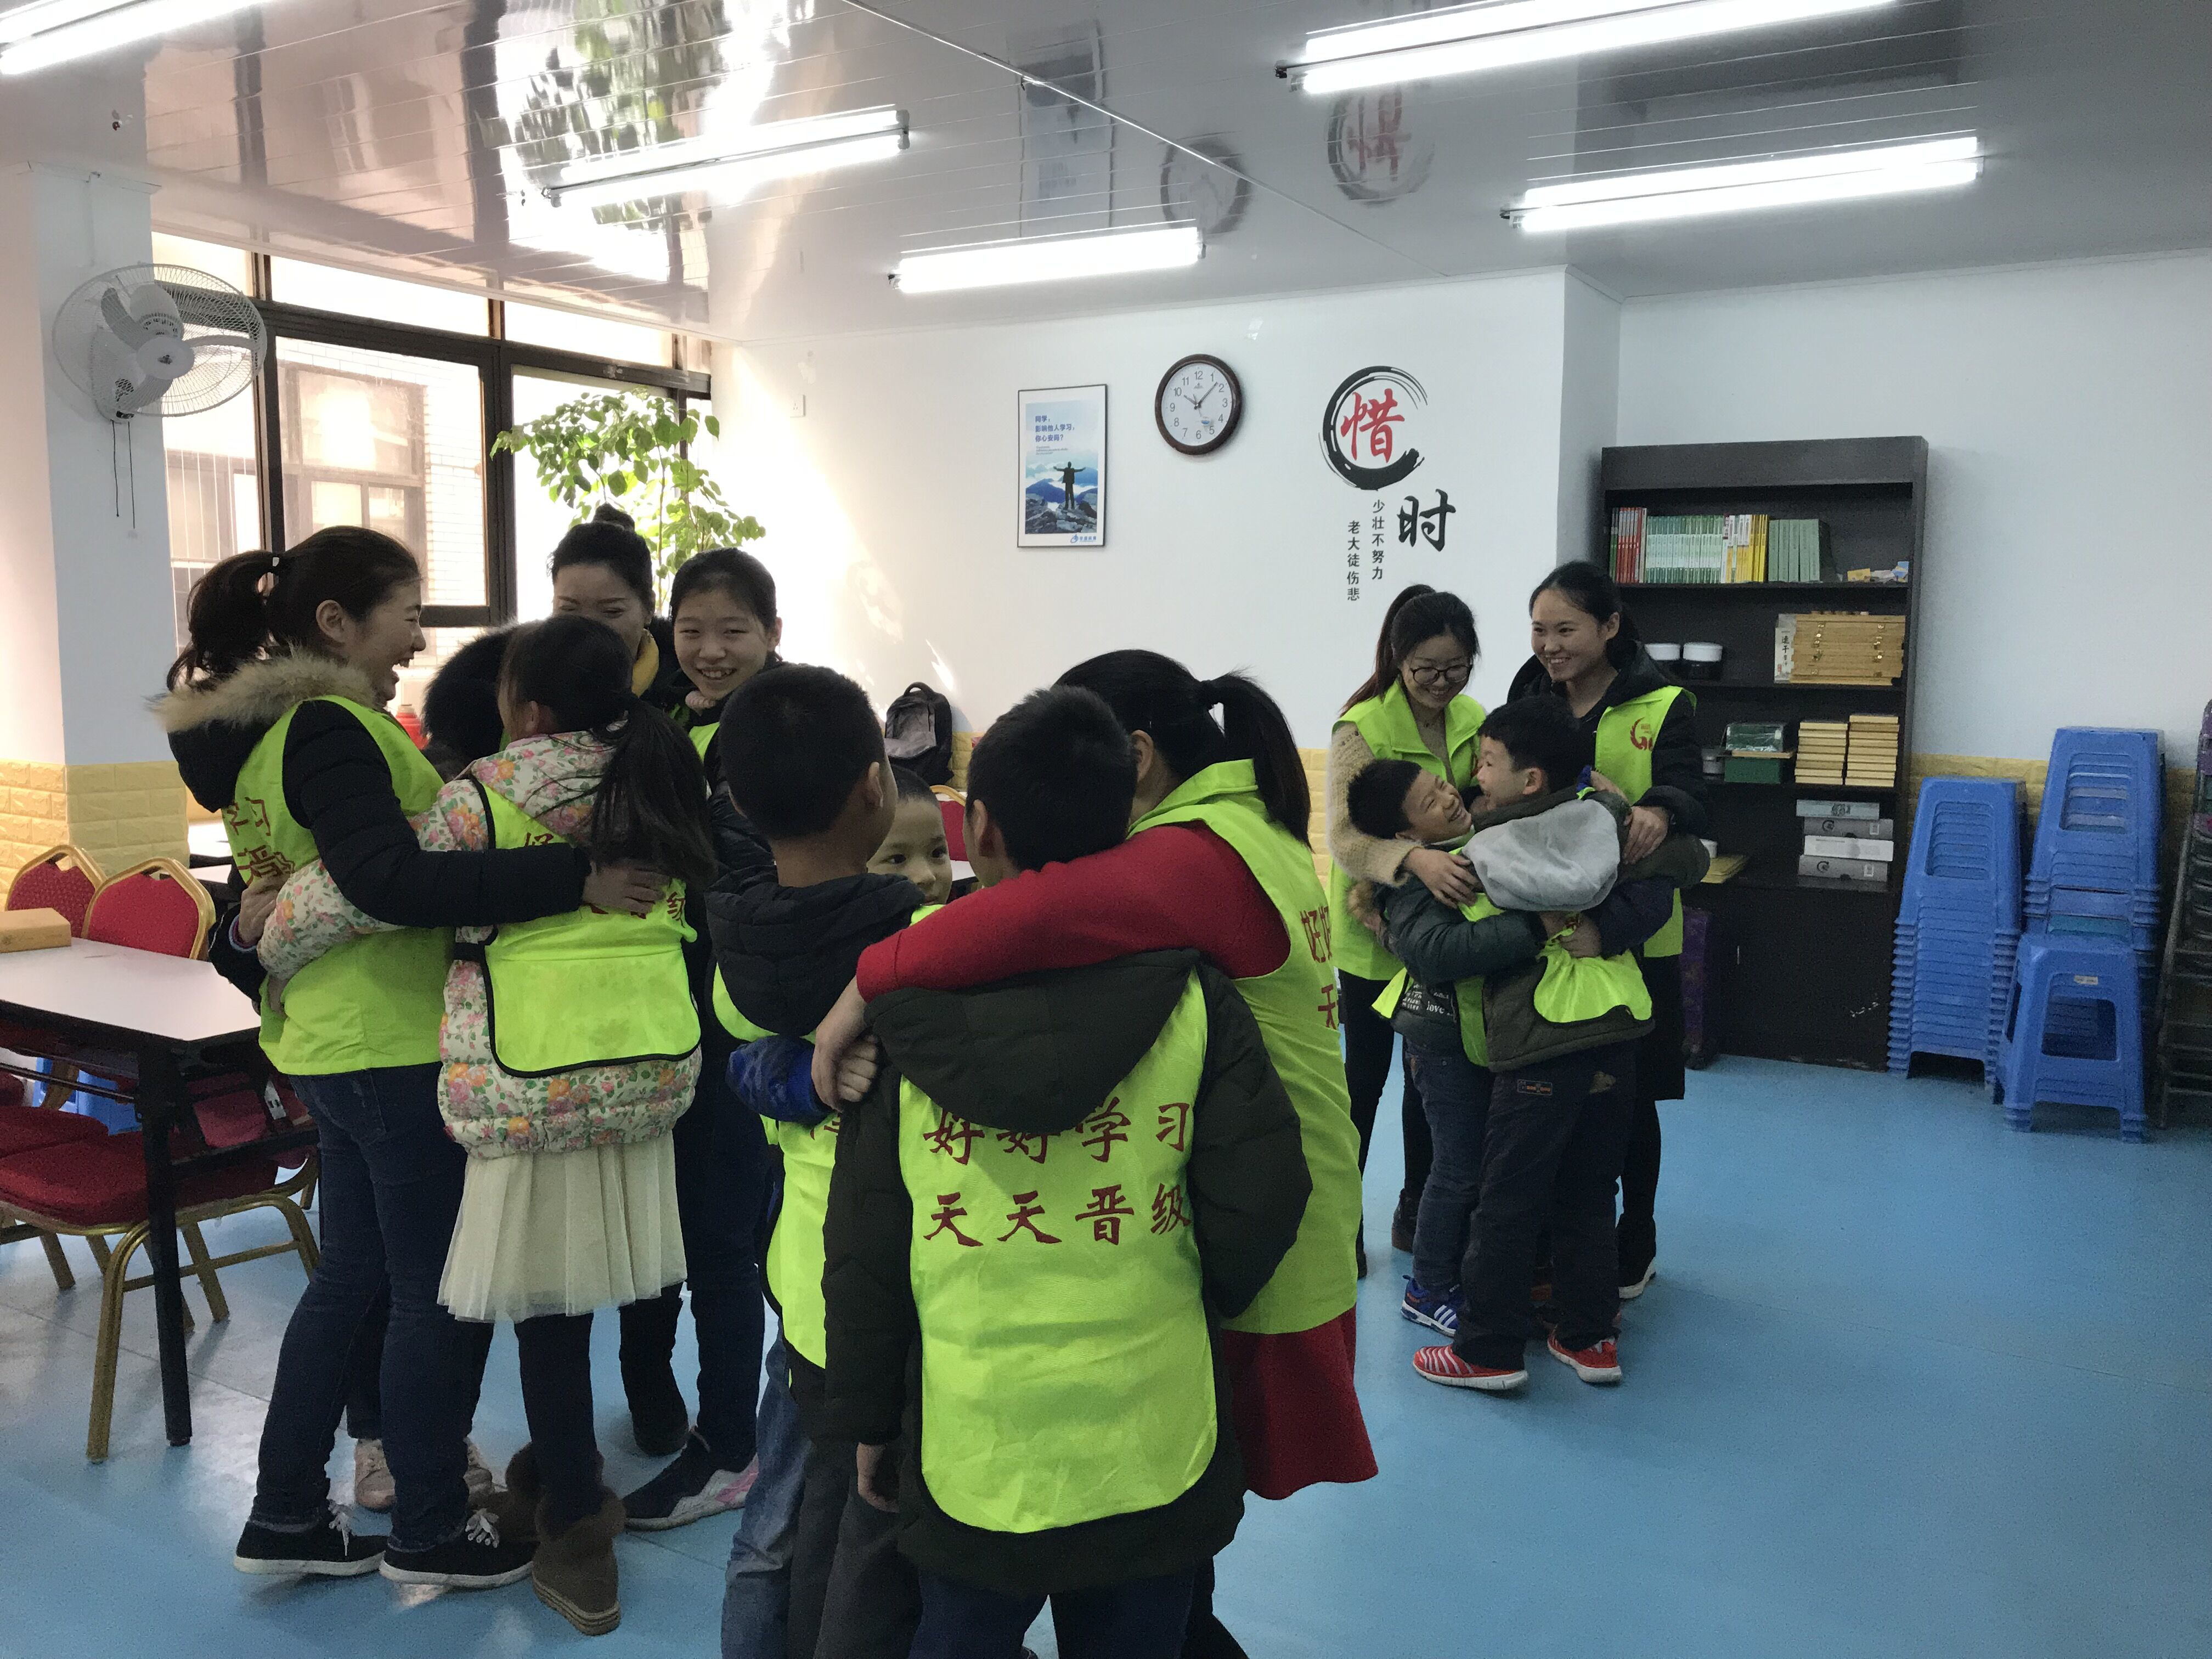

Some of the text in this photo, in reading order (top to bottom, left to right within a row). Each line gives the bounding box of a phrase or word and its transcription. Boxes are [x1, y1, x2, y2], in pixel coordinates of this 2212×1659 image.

[1194, 370, 1203, 380] 12
[1210, 373, 1214, 382] 1
[1182, 376, 1189, 386] 11
[1173, 387, 1182, 397] 10
[1218, 383, 1224, 393] 2
[1170, 402, 1176, 412] 9
[1222, 398, 1228, 408] 3
[1173, 417, 1180, 427] 8
[1218, 413, 1224, 423] 4
[1209, 425, 1215, 435] 5
[1340, 388, 1405, 463] 惜
[1182, 427, 1188, 437] 7
[1195, 430, 1201, 439] 6
[1397, 489, 1456, 552] 时
[1372, 499, 1385, 580] 少壮不努力
[1347, 520, 1361, 602] 老大徒伤悲
[923, 1097, 1190, 1166] 好好学习
[923, 1183, 1192, 1247] 天天晋级
